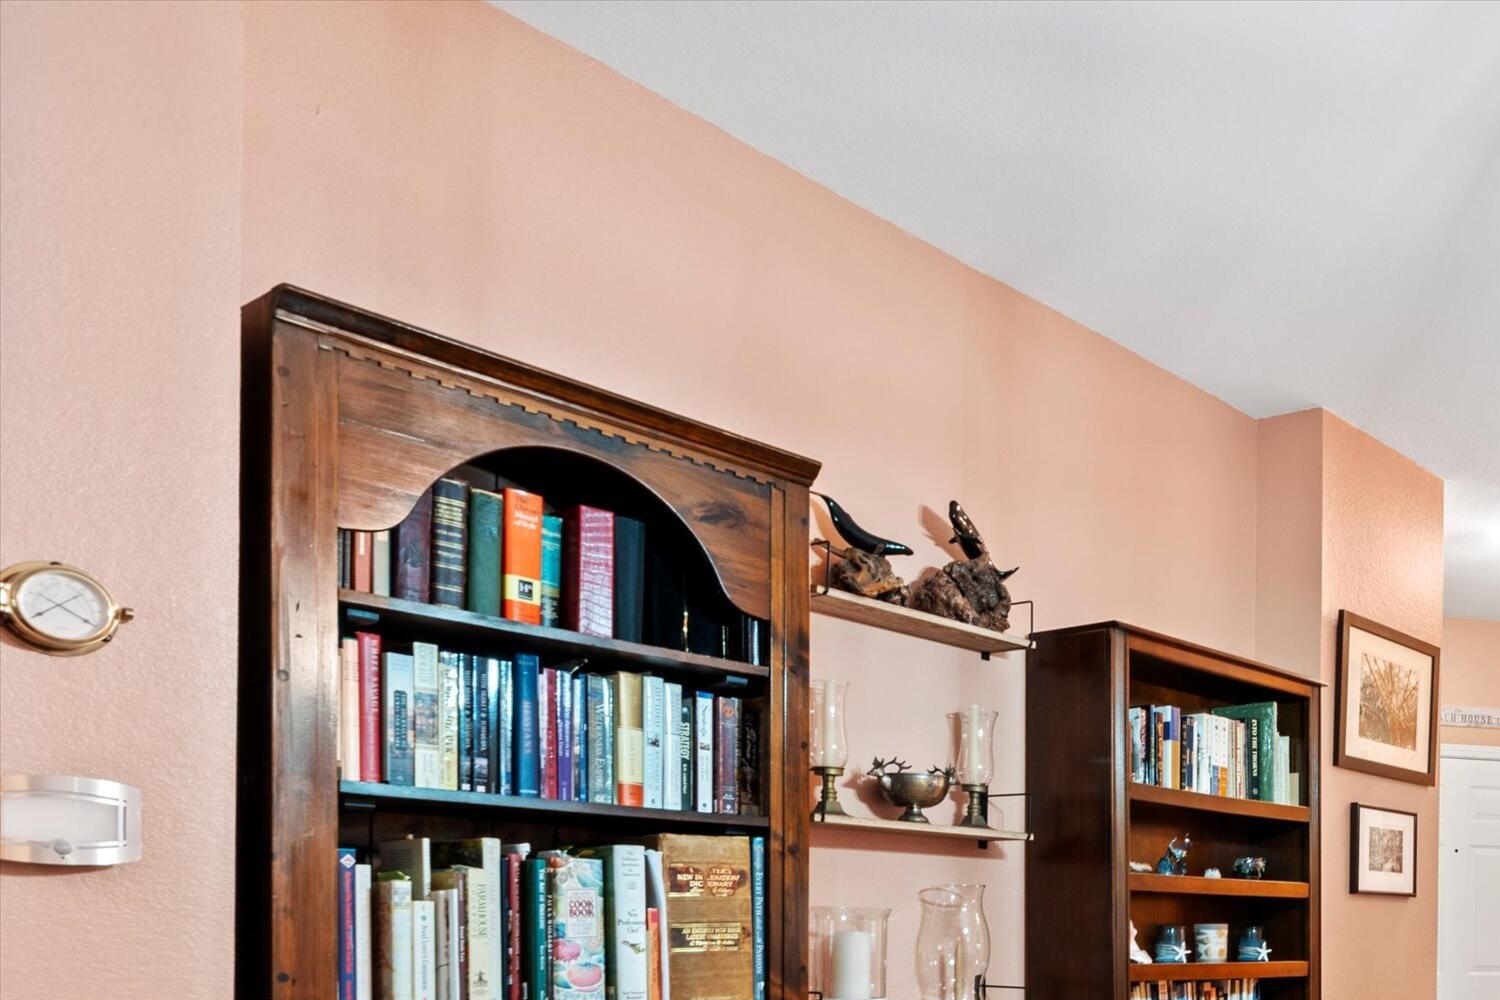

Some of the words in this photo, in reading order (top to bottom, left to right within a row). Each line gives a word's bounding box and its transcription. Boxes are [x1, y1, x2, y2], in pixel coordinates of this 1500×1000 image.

[1461, 713, 1493, 725] HOUSE
[680, 722, 690, 760] STRATEGY
[755, 871, 764, 896] EVERY
[477, 883, 489, 939] FARMHOUSE
[568, 900, 594, 909] COOK
[568, 908, 595, 918] BOOK
[755, 896, 764, 916] PATH
[755, 944, 764, 975] PASSION
